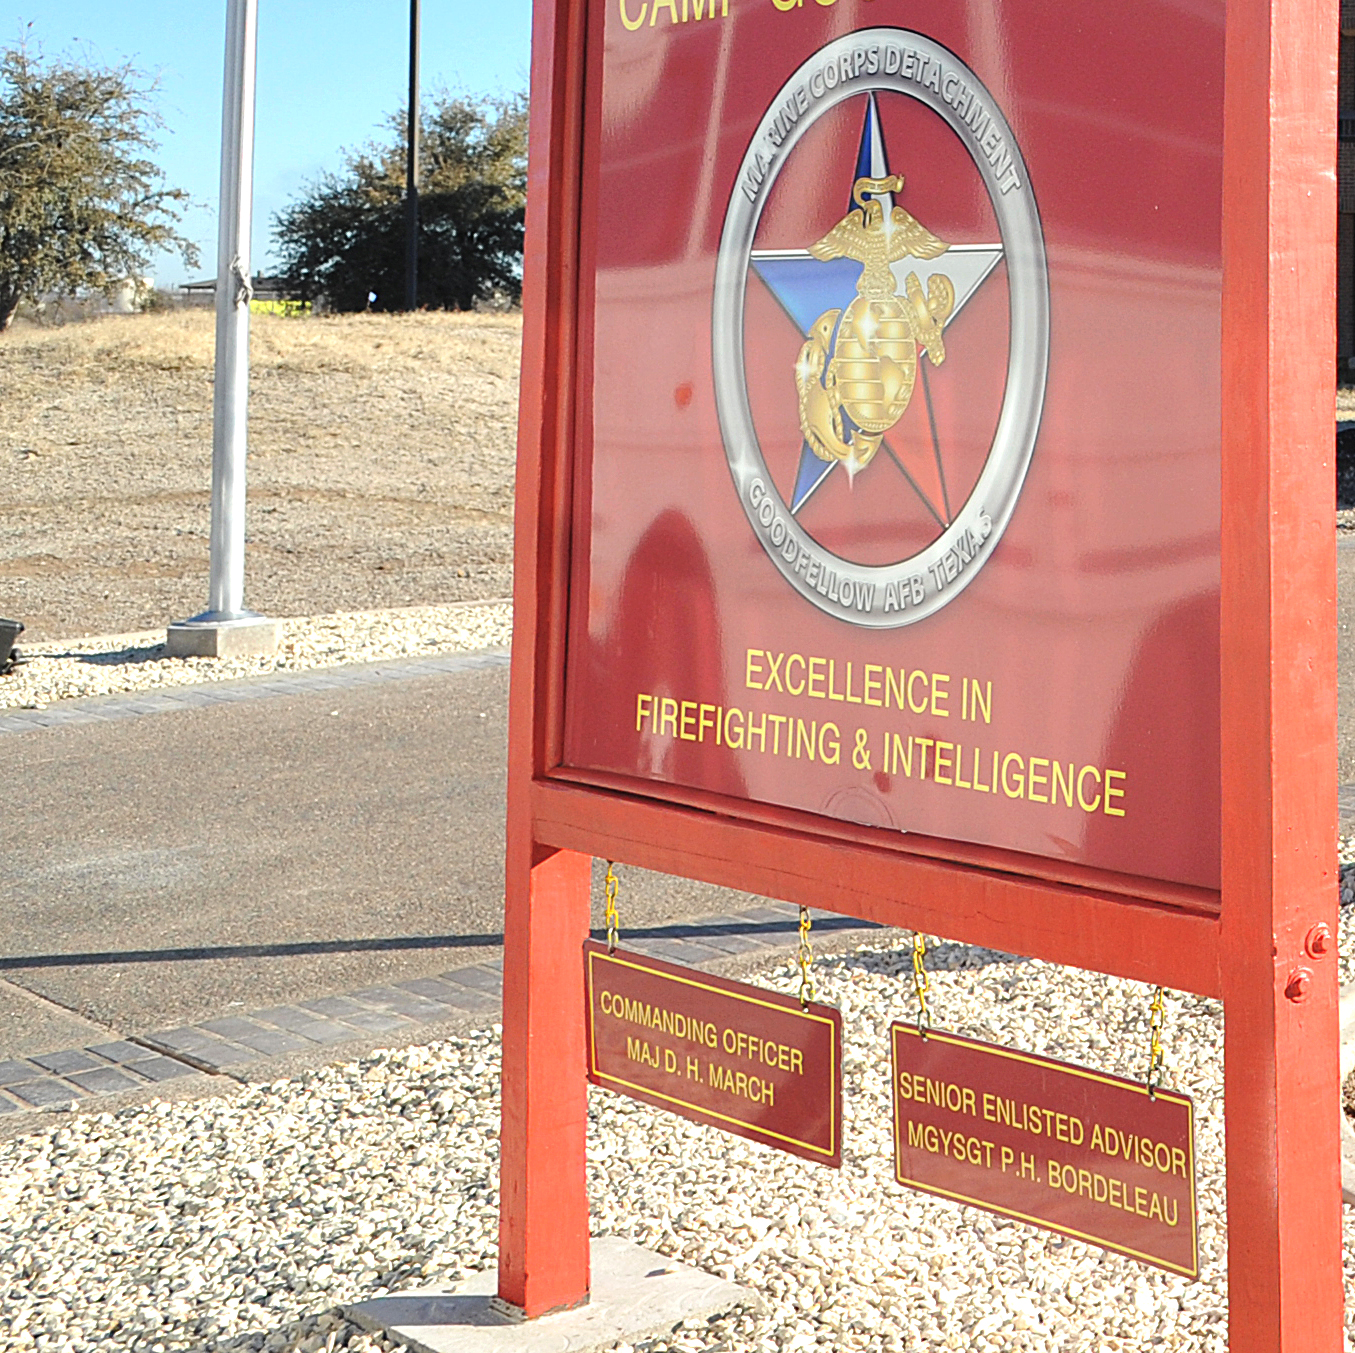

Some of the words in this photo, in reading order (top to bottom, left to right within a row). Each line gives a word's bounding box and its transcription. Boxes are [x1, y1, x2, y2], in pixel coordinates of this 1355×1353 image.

[741, 86, 810, 202] MARINE
[808, 45, 880, 98] CORPS
[884, 45, 1022, 196] DETACHMENT
[749, 477, 876, 612] GOODFELLOW
[883, 575, 926, 613] AFB
[928, 508, 993, 591] TEXAS
[744, 648, 950, 718] EXCELLENCE
[960, 677, 993, 725] IN
[635, 693, 842, 766] FIREFIGHTING
[851, 728, 873, 771] &
[883, 731, 1127, 818] INTELLIGENCE
[600, 990, 718, 1049] COMMANDING
[722, 1027, 804, 1076] OFFICER
[626, 1036, 659, 1068] MAJ
[664, 1049, 682, 1075] D.
[686, 1056, 704, 1085] H.
[708, 1063, 775, 1107] MARCH
[899, 1072, 977, 1117] SENIOR
[983, 1094, 1085, 1146] ENLISTED
[1090, 1124, 1188, 1178] ADVISOR
[908, 1120, 996, 1167] MGYSGT
[1048, 1160, 1179, 1227] BORDELEAU
